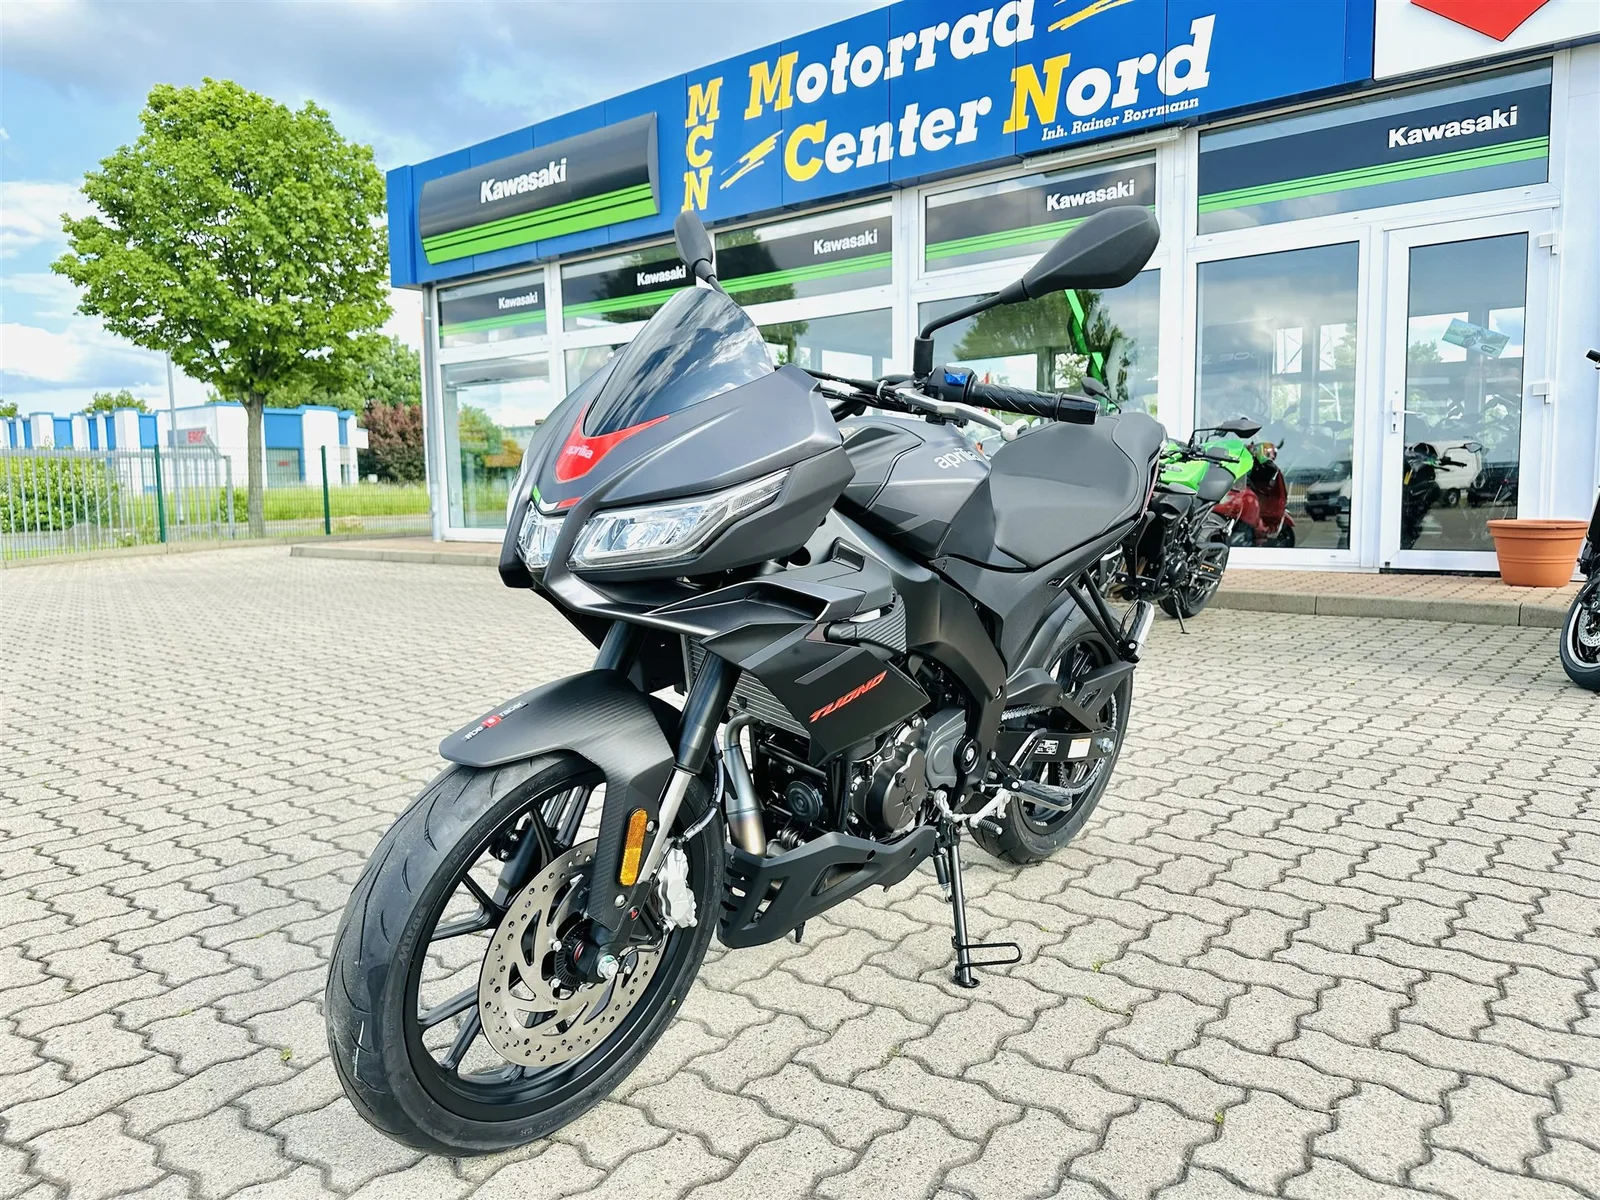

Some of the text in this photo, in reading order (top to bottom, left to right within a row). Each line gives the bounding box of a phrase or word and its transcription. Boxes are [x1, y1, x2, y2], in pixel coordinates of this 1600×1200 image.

[745, 0, 1035, 120] Motorrad
[783, 14, 1216, 182] Center Nord
[1041, 97, 1199, 141] Inh. Rainer Borrmann
[1388, 105, 1519, 149] Kawasaki
[480, 157, 567, 204] Kawasaki
[1046, 178, 1135, 212] Kawasaki
[813, 228, 878, 255] Kawasaki
[636, 264, 687, 287] Kawasaki
[498, 291, 538, 310] Kawasaki
[565, 444, 594, 459] aprilia
[808, 669, 888, 723] TUONO
